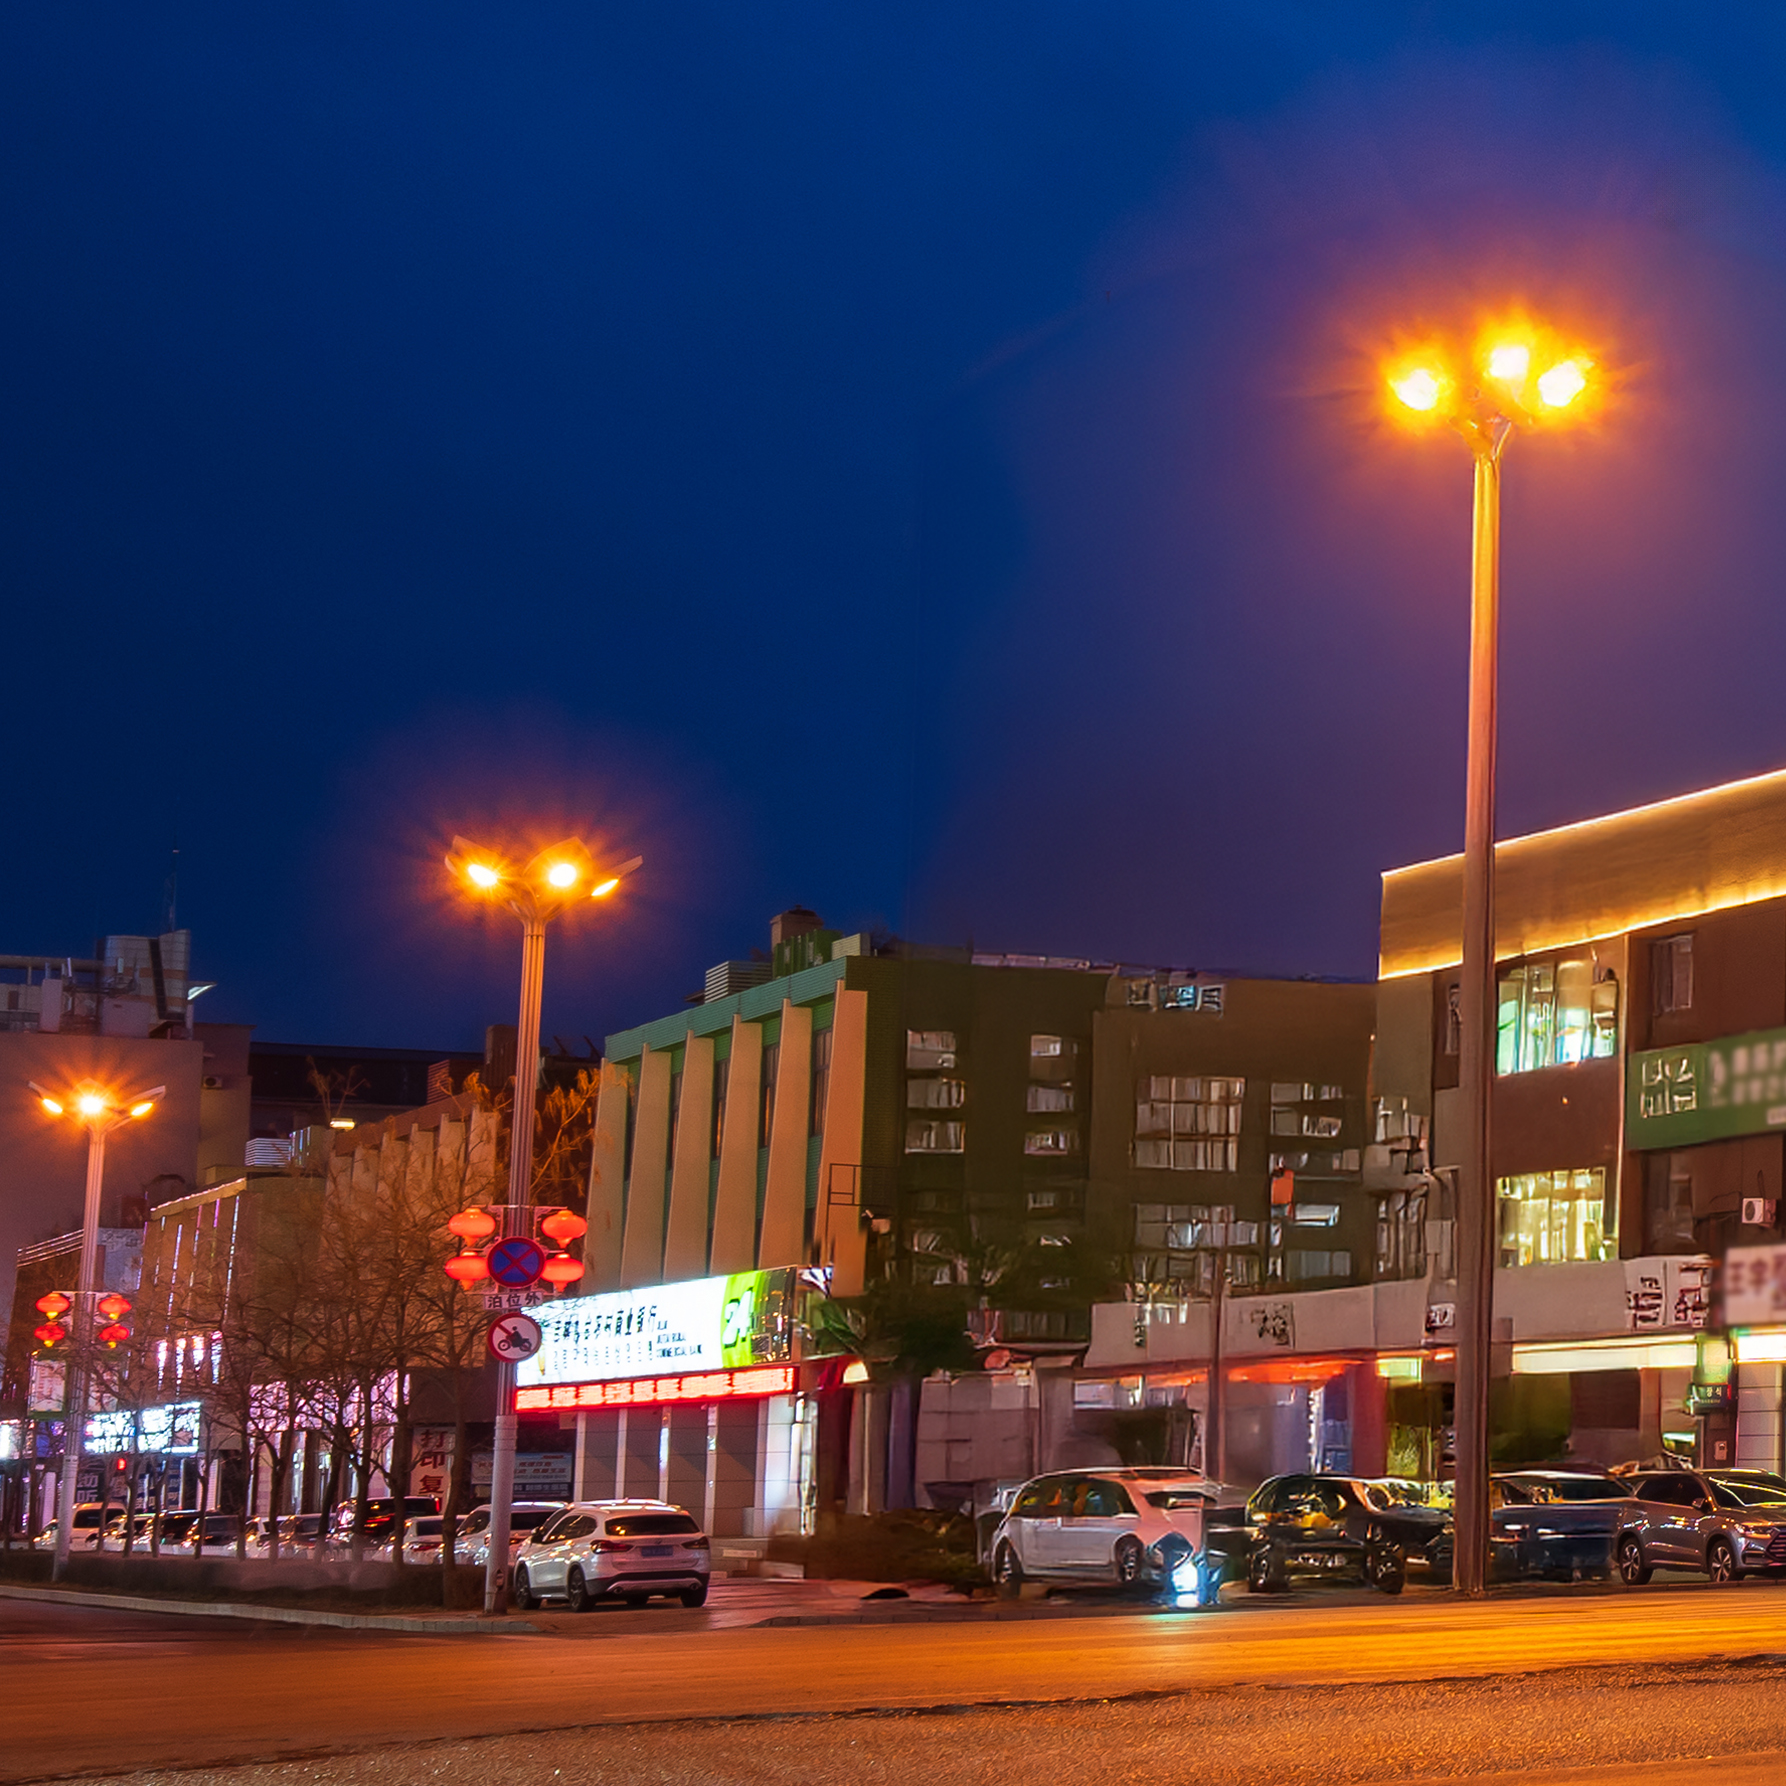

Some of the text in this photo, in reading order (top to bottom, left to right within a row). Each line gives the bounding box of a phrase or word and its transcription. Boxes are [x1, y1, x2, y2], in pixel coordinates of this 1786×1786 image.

[487, 1292, 541, 1309] 泊位外
[418, 1429, 447, 1512] 打印复
